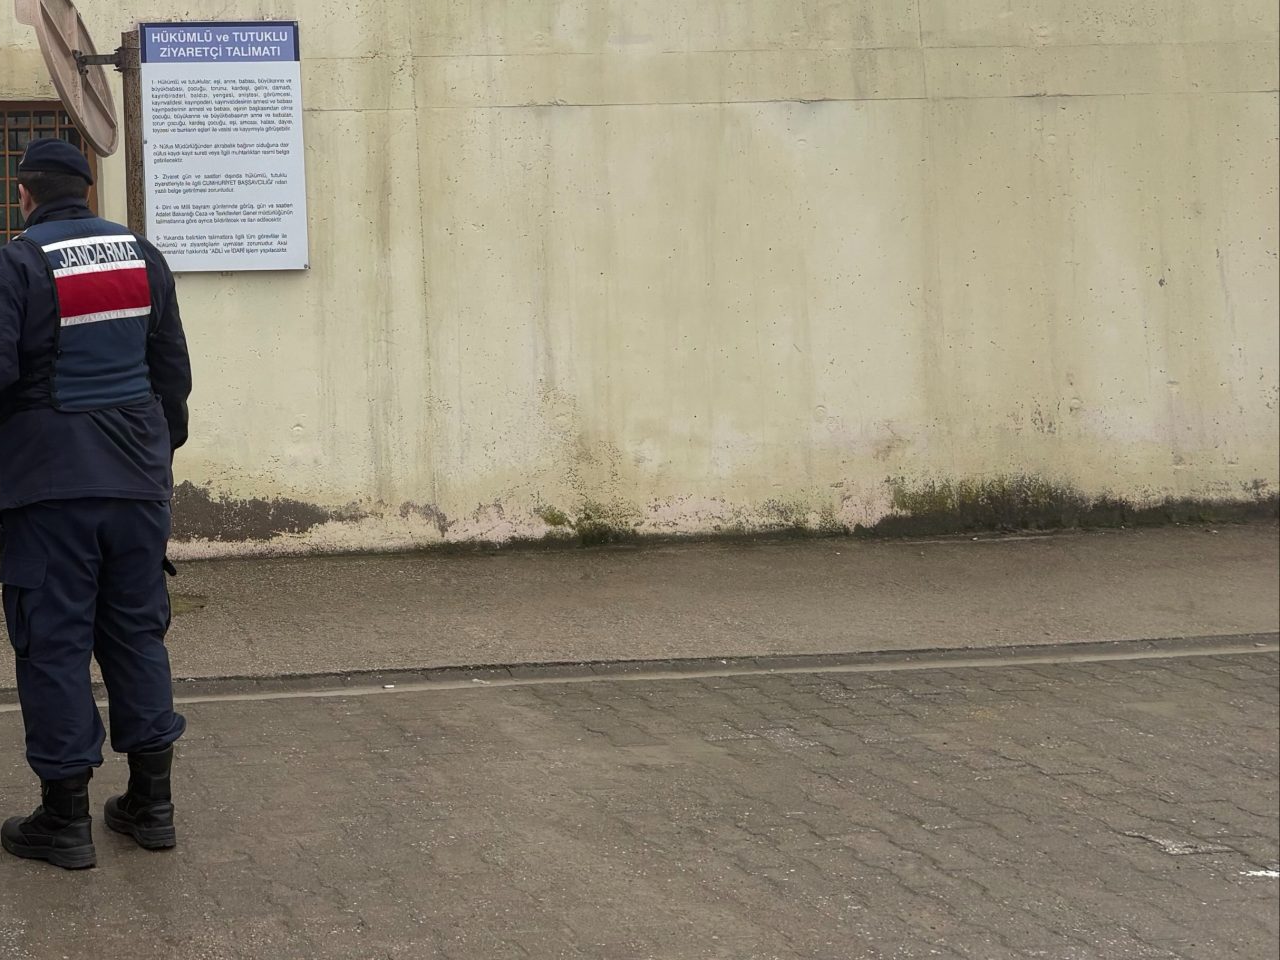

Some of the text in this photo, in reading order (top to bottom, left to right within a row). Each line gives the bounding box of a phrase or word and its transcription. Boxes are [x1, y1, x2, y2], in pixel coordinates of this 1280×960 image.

[151, 29, 288, 43] HÜKÜMLÜ ve TUTUKLU
[159, 43, 281, 59] ZİYARETÇİ TALİMATI
[59, 241, 138, 268] JANDARMA
